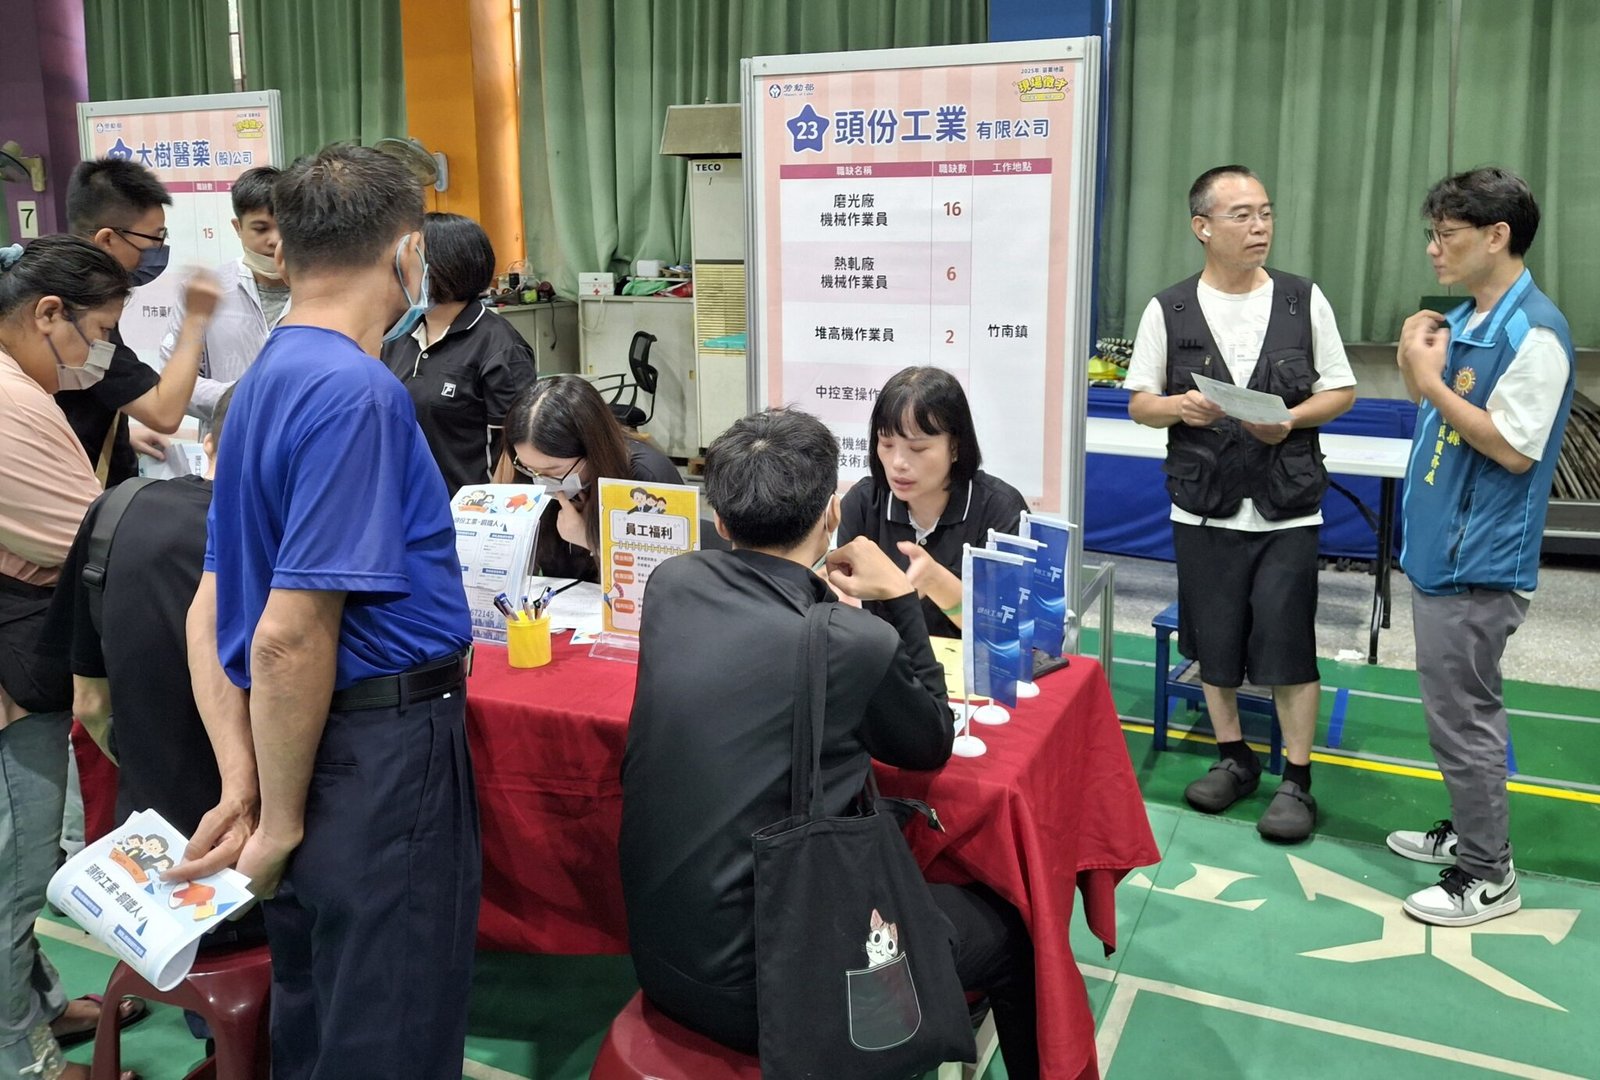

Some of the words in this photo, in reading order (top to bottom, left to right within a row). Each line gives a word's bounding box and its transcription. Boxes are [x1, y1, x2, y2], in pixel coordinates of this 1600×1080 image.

[783, 83, 815, 94] 勞動部
[796, 120, 819, 140] 23
[834, 106, 967, 145] 頭份工業
[976, 119, 1049, 140] 有限公司
[136, 140, 210, 168] 大樹醫藥
[695, 163, 722, 172] TECO
[836, 165, 872, 176] 職缺名稱
[938, 163, 967, 175] 職缺數
[992, 162, 1032, 172] 工作地點
[833, 193, 875, 209] 磨光廠
[943, 200, 962, 217] 16
[20, 208, 34, 229] 7
[820, 210, 888, 227] 機械作業員
[203, 228, 214, 240] 15
[833, 256, 875, 272] 熱軋廠
[820, 274, 888, 290] 機械作業員
[946, 266, 957, 282] 6
[814, 326, 895, 342] 堆高機作業員
[945, 329, 955, 344] 2
[987, 324, 1028, 339] 竹南鎮
[626, 522, 673, 540] 員工福利
